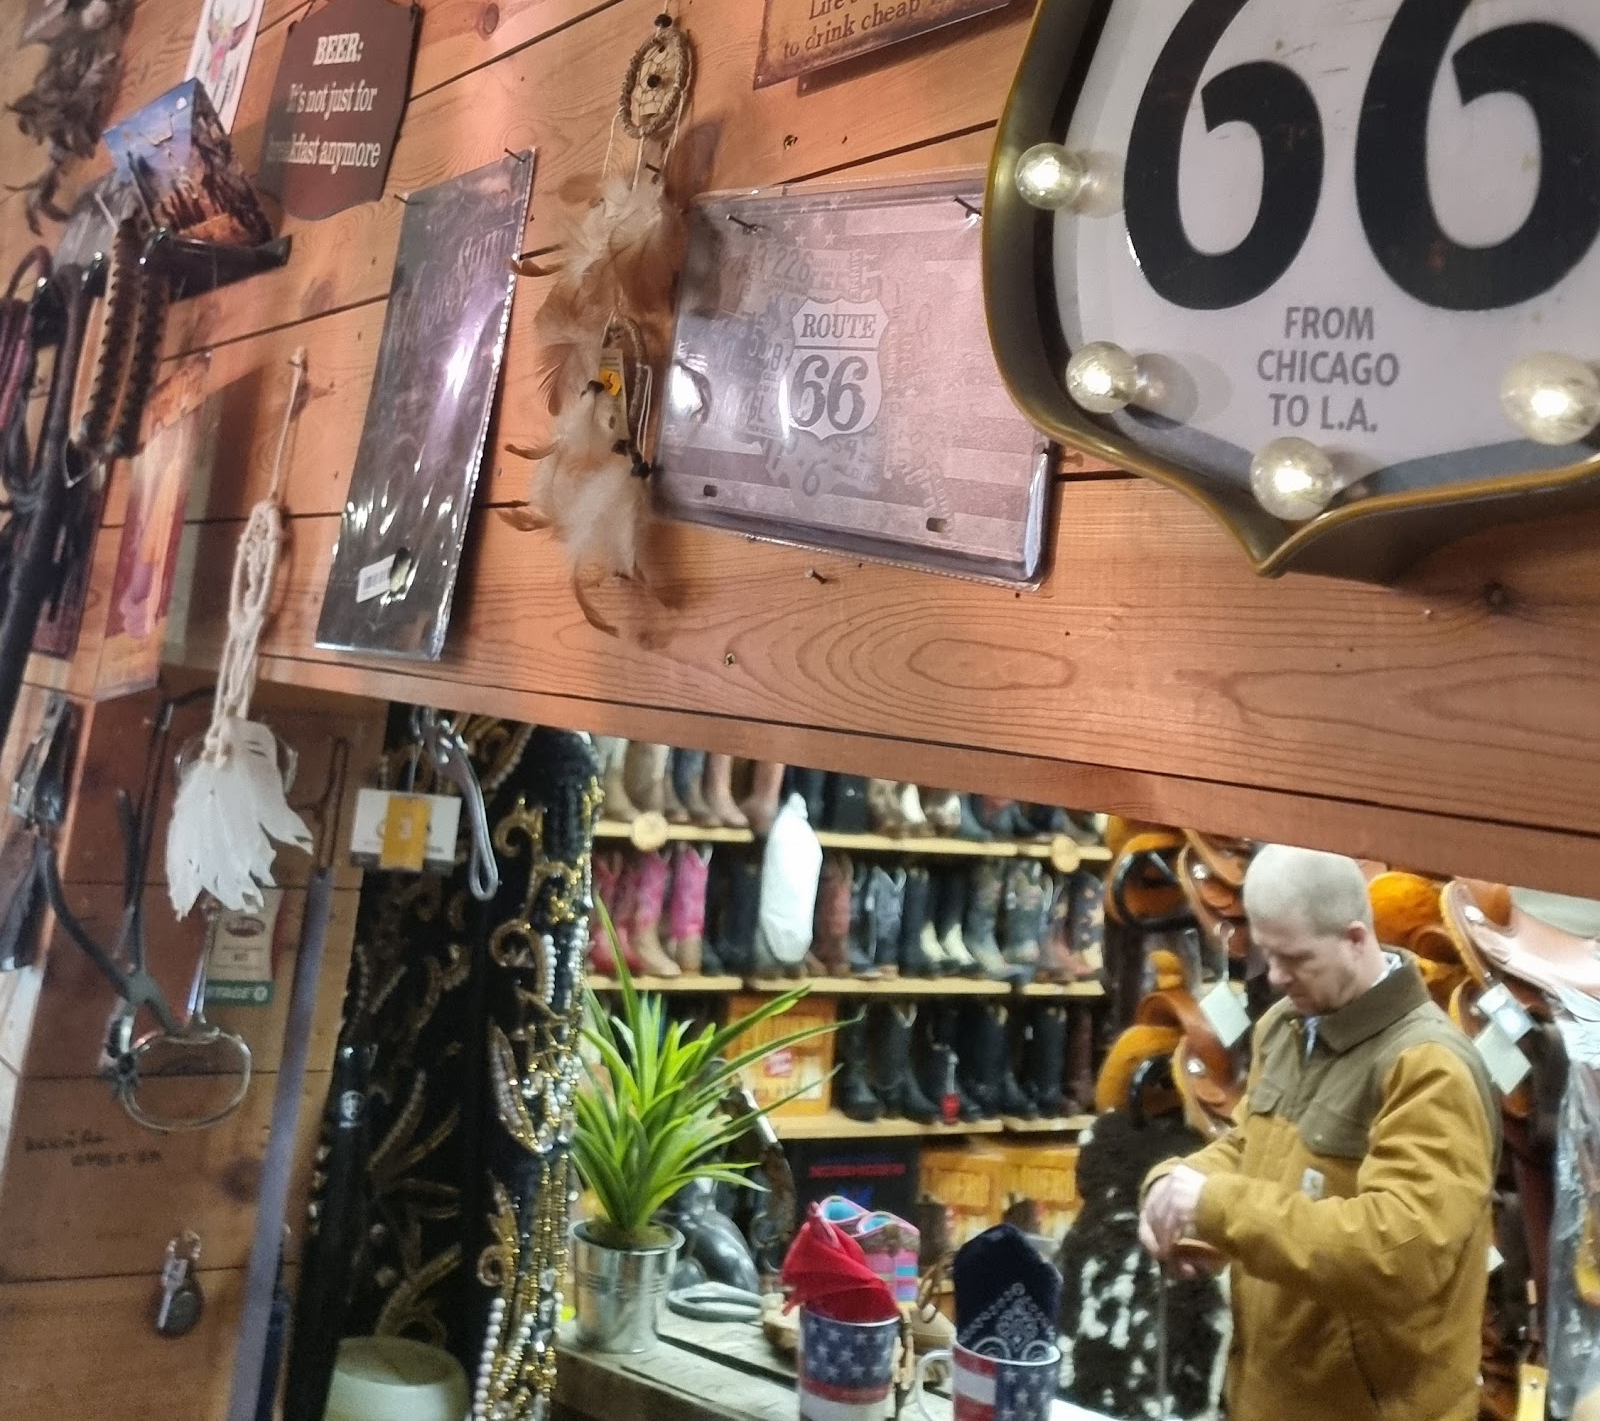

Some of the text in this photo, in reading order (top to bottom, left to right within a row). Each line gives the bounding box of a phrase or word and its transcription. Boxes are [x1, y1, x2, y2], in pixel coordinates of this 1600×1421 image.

[312, 32, 364, 66] BEER:
[784, 39, 799, 60] to
[805, 14, 855, 51] drink
[861, 1, 920, 31] cheap
[305, 83, 328, 113] not
[324, 80, 354, 120] just
[354, 79, 378, 112] for
[318, 140, 381, 174] anymore
[800, 313, 877, 339] ROUTE
[1284, 306, 1375, 341] FROM
[1257, 349, 1400, 387] CHICAGO
[789, 353, 869, 431] 66
[1269, 393, 1378, 432] TO L.A.
